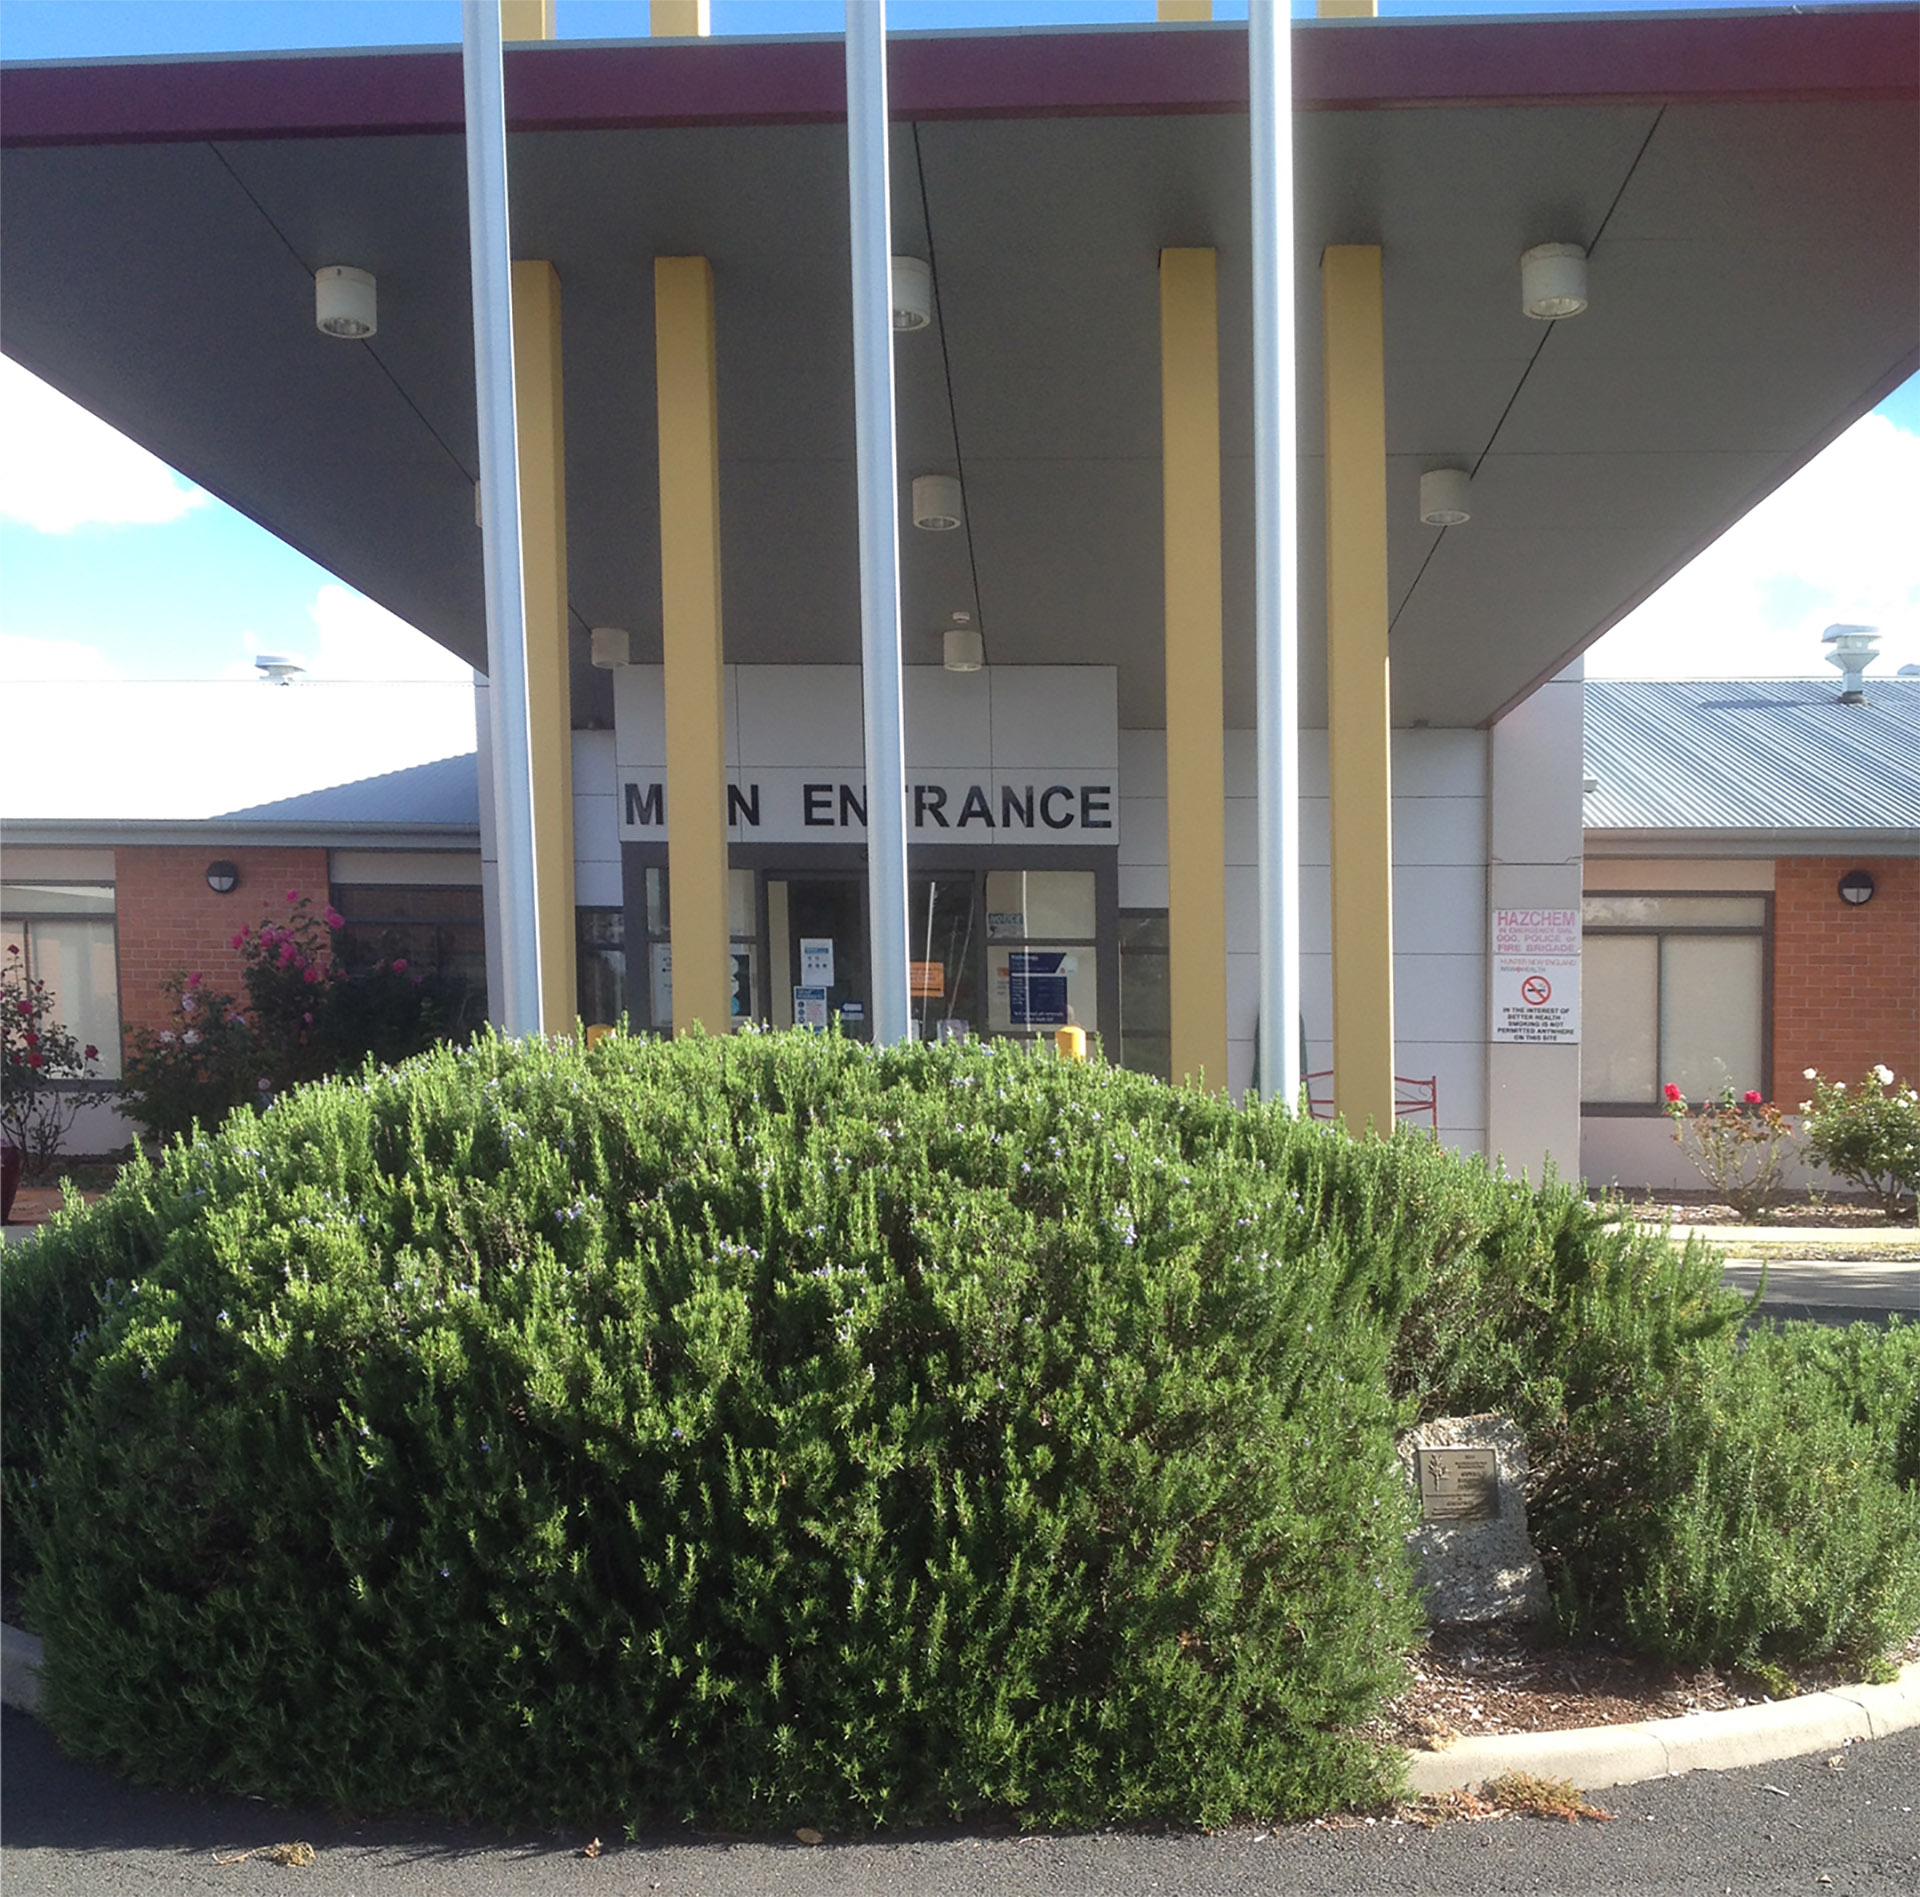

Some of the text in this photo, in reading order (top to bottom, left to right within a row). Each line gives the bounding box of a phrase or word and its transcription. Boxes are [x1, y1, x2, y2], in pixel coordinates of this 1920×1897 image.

[625, 783, 1113, 829] MN ENRANCE
[1497, 911, 1575, 926] HAZCHEM
[1524, 934, 1561, 942] POLICE
[1497, 944, 1574, 952] FIRE BRIGADE
